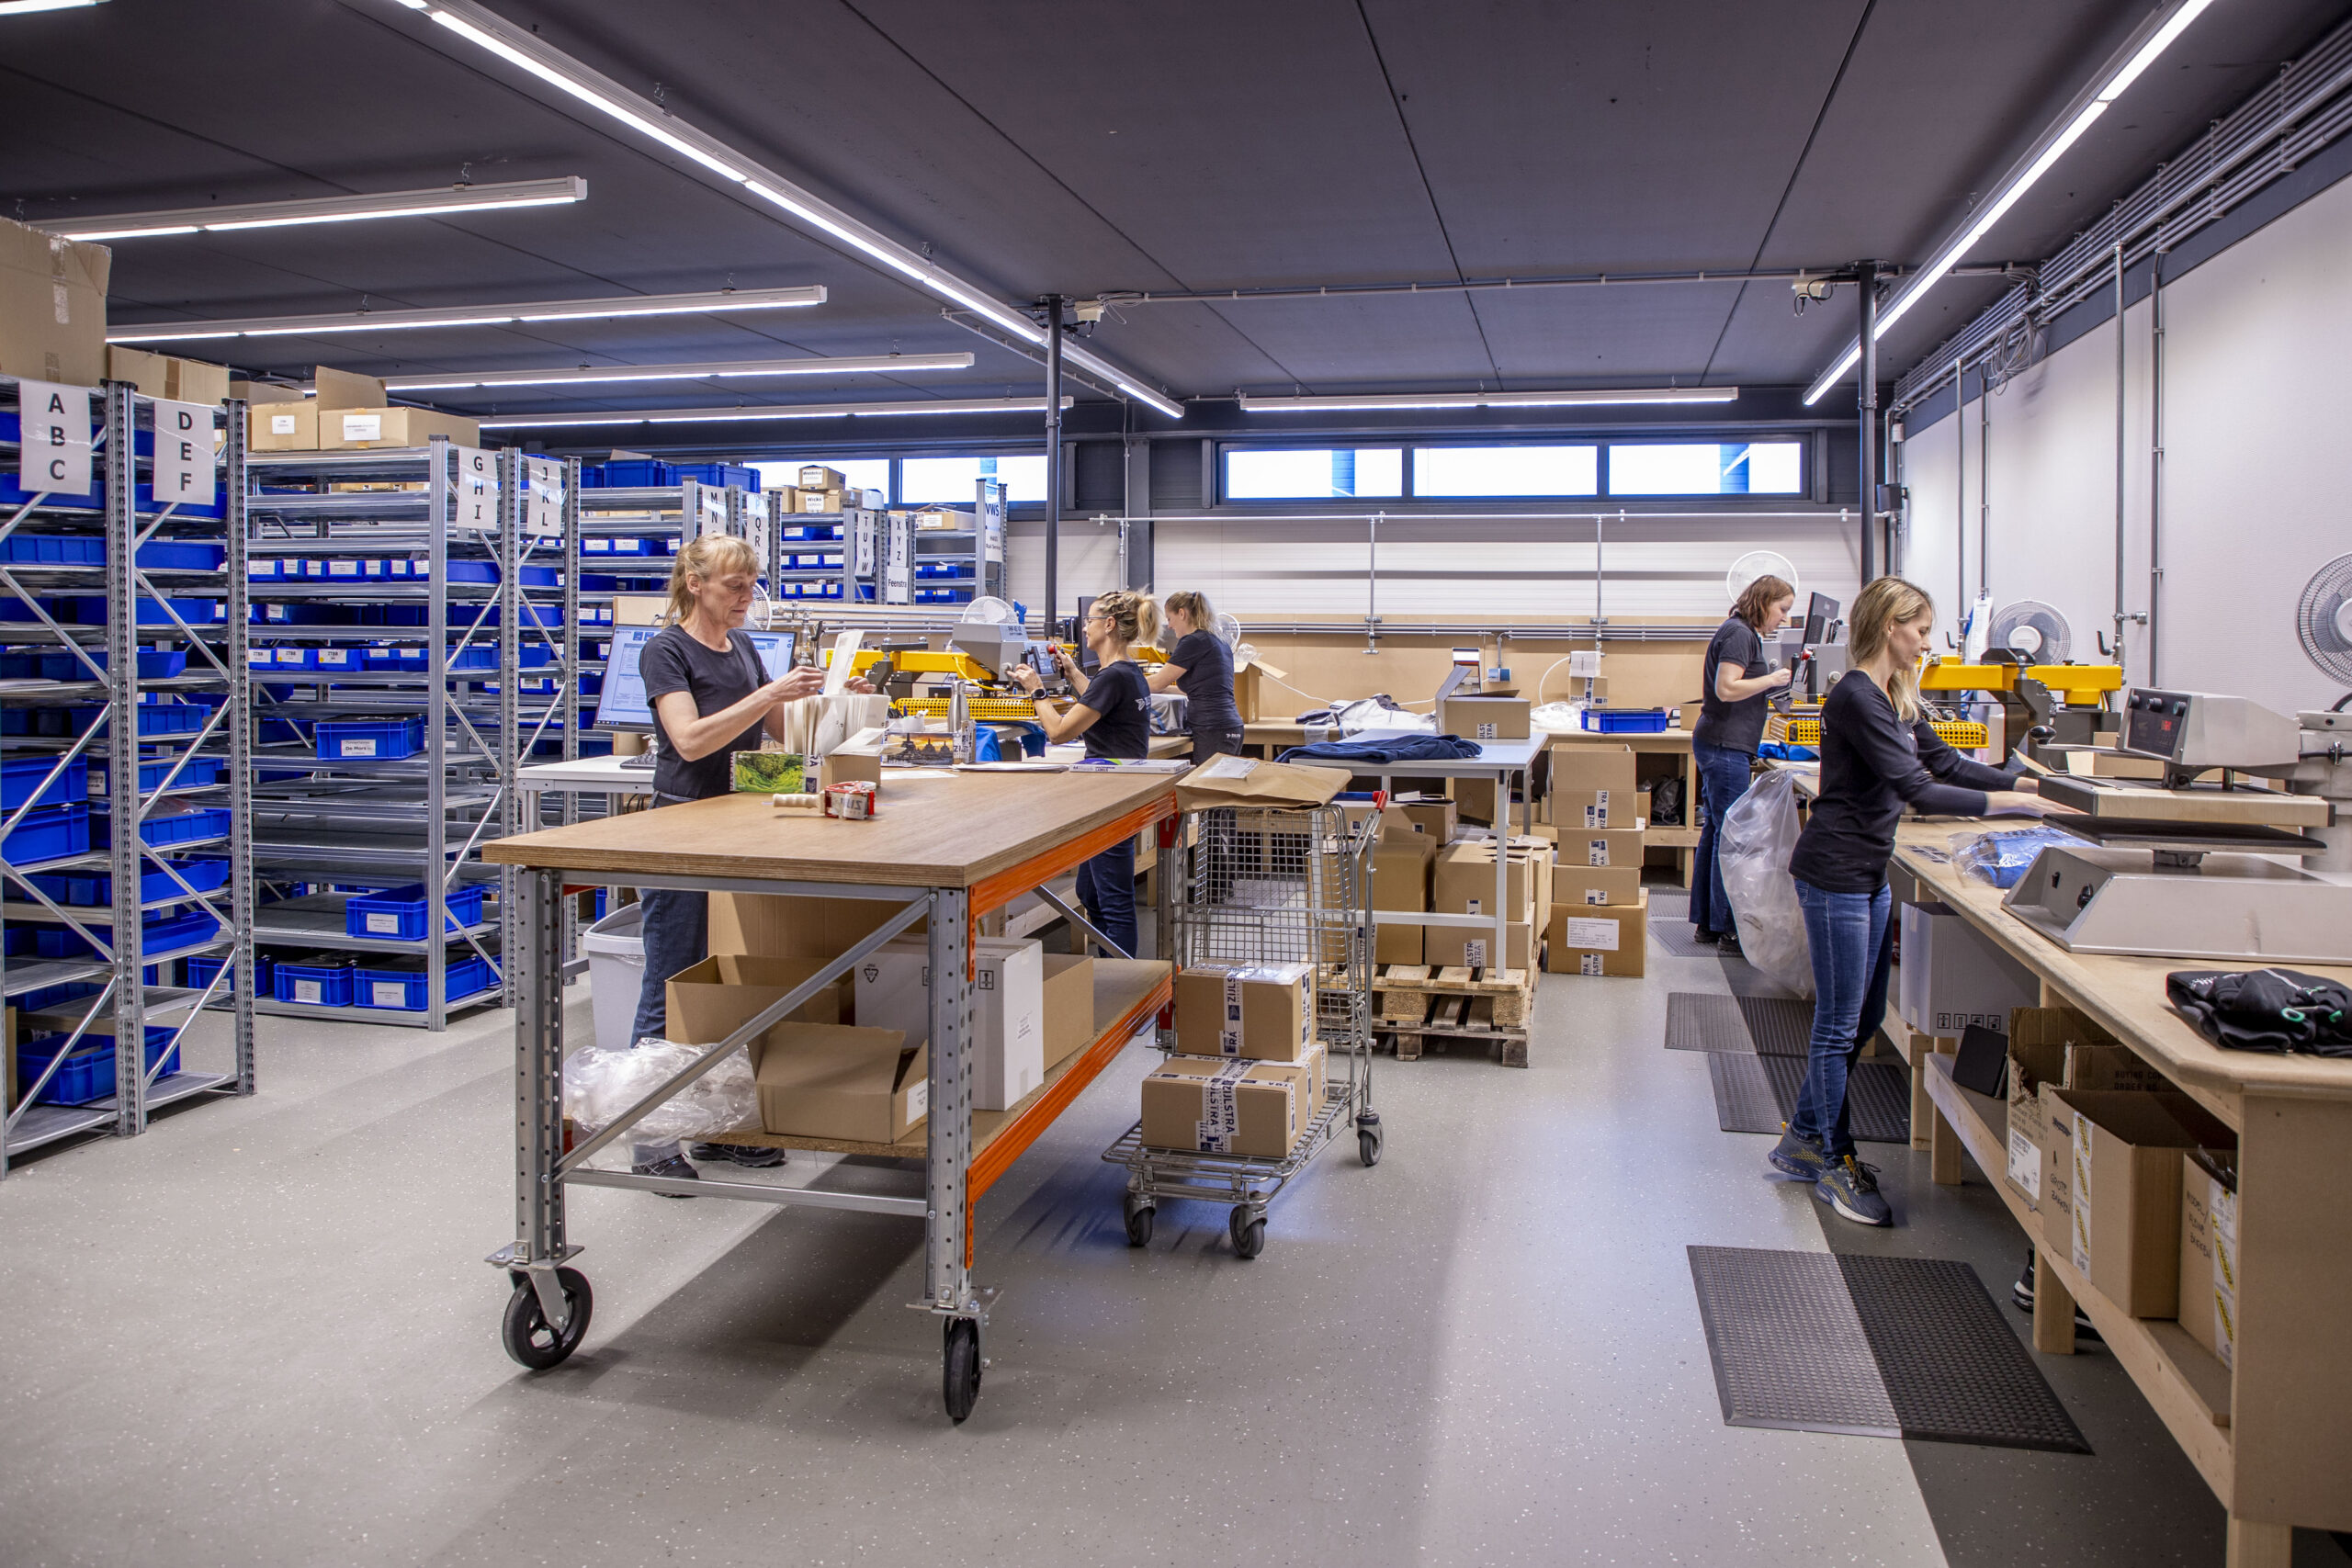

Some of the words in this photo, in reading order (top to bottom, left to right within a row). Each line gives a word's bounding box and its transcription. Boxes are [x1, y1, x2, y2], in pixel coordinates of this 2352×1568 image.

[49, 393, 65, 414] A
[178, 412, 193, 430] D
[51, 426, 65, 446] B
[181, 443, 192, 461] E
[50, 459, 65, 480] C
[473, 456, 483, 471] G
[542, 467, 548, 480] J
[181, 472, 192, 491] F
[474, 480, 483, 495] H
[542, 490, 549, 504] K
[710, 491, 718, 504] M
[474, 504, 481, 520] I
[985, 503, 1000, 516] VWS
[541, 512, 548, 526] L
[711, 511, 718, 524] N
[755, 517, 762, 531] Q
[865, 516, 868, 526] T
[897, 521, 901, 531] X
[754, 536, 761, 547] R
[864, 532, 868, 542] U
[897, 536, 901, 546] Y
[864, 547, 868, 558] V
[897, 551, 901, 560] Z
[862, 562, 868, 572] W
[888, 579, 908, 588] Feenstra
[1222, 1085, 1235, 1134] ZIJLSTRA
